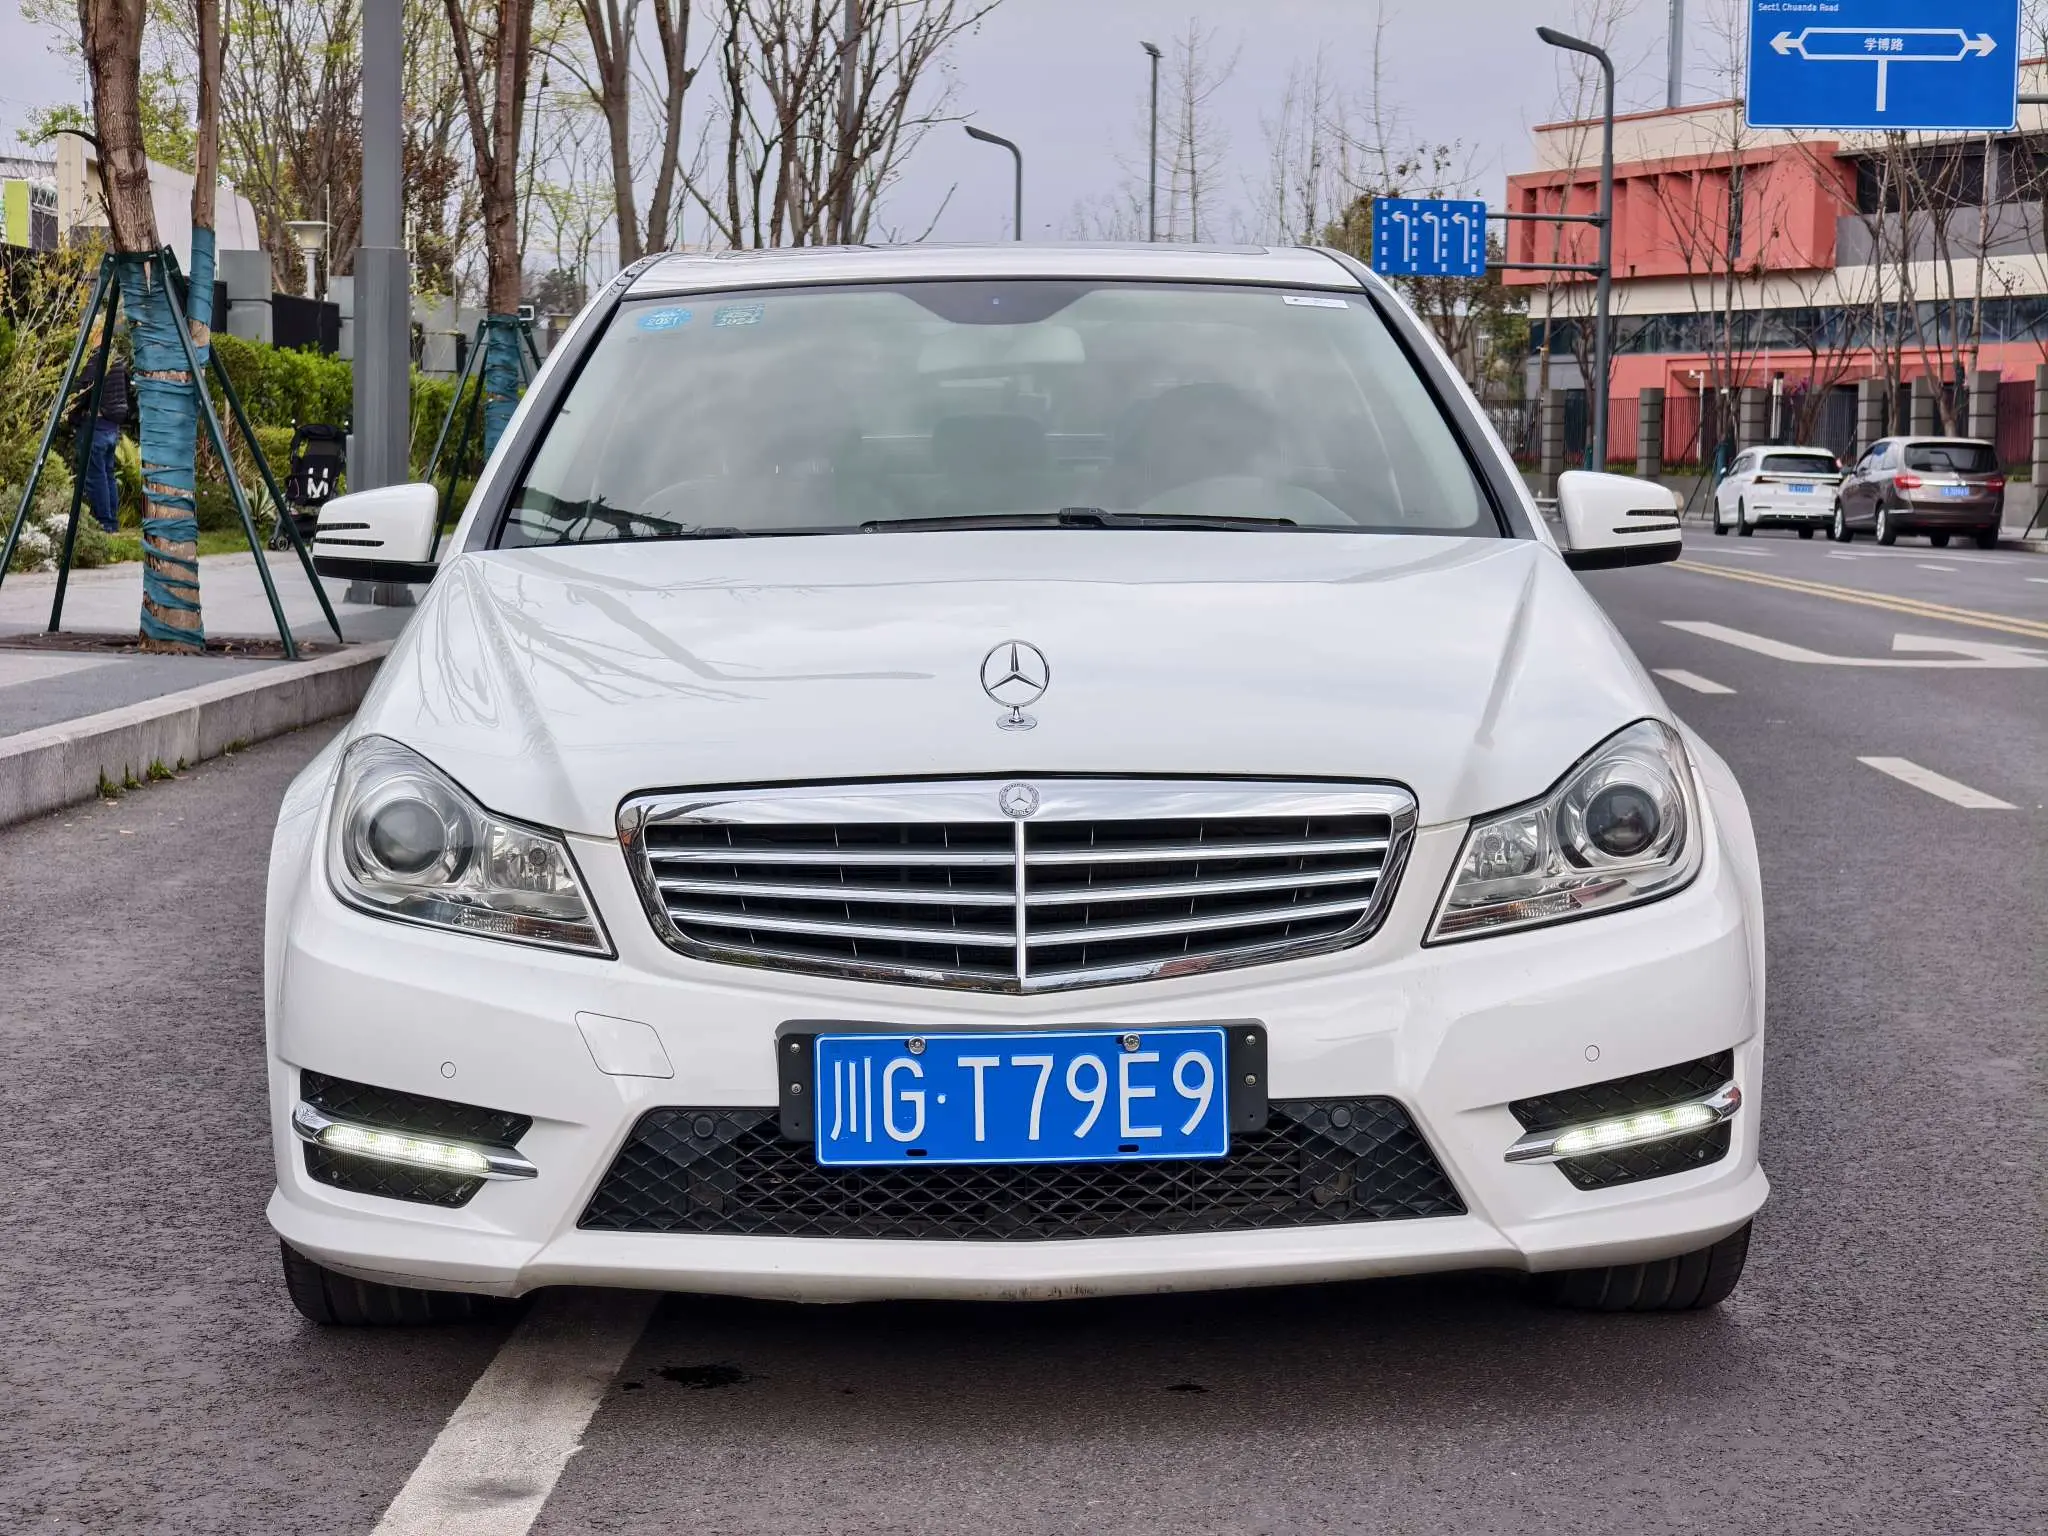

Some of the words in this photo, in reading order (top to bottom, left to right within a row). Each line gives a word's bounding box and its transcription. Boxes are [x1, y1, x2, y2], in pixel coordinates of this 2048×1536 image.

[1819, 3, 1839, 12] Road
[1863, 37, 1904, 51] 学博路
